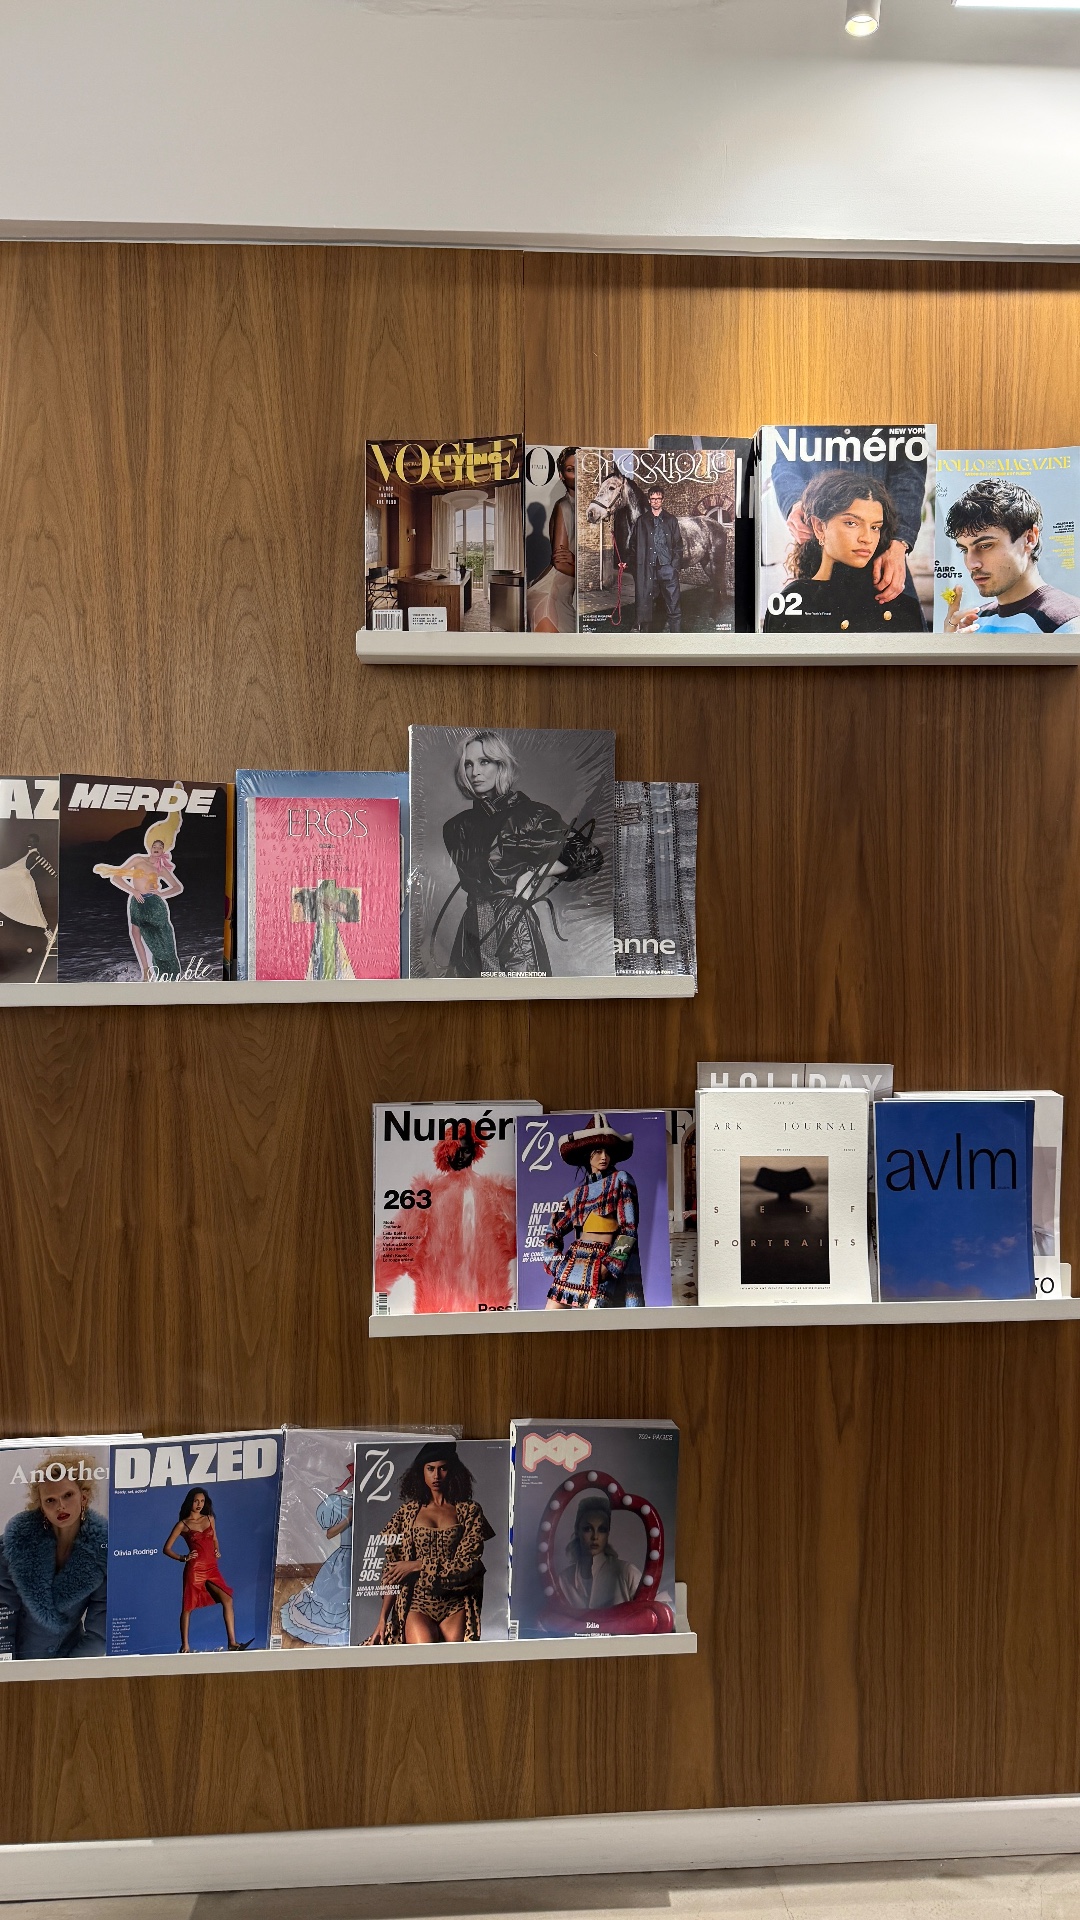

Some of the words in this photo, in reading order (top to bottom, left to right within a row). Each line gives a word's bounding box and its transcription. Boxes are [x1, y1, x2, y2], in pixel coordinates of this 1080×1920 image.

[771, 428, 929, 462] Numéro
[368, 438, 520, 485] VOGUE
[432, 451, 503, 467] LIVING
[997, 456, 1071, 471] MAGAZINE
[767, 592, 803, 616] 02
[68, 783, 216, 814] MERDE
[287, 809, 368, 838] EROS
[384, 1110, 516, 1142] Numér
[713, 1122, 743, 1131] ARK
[783, 1122, 856, 1131] JOURNAL
[521, 1119, 555, 1173] 72
[885, 1133, 1017, 1191] avlm
[383, 1189, 432, 1210] 263
[531, 1201, 567, 1214] MADE
[528, 1214, 542, 1225] IN
[527, 1224, 548, 1237] THE
[524, 1236, 546, 1248] 90s
[714, 1239, 856, 1247] PORTRAITS
[522, 1432, 592, 1472] POP
[114, 1438, 278, 1489] DAZED
[359, 1448, 395, 1503] 72
[367, 1533, 404, 1546] MADE
[113, 1549, 132, 1557] Olivia
[133, 1548, 158, 1556] Rodrigo
[364, 1546, 378, 1558] IN
[362, 1558, 385, 1570] THE
[359, 1569, 381, 1581] 90s
